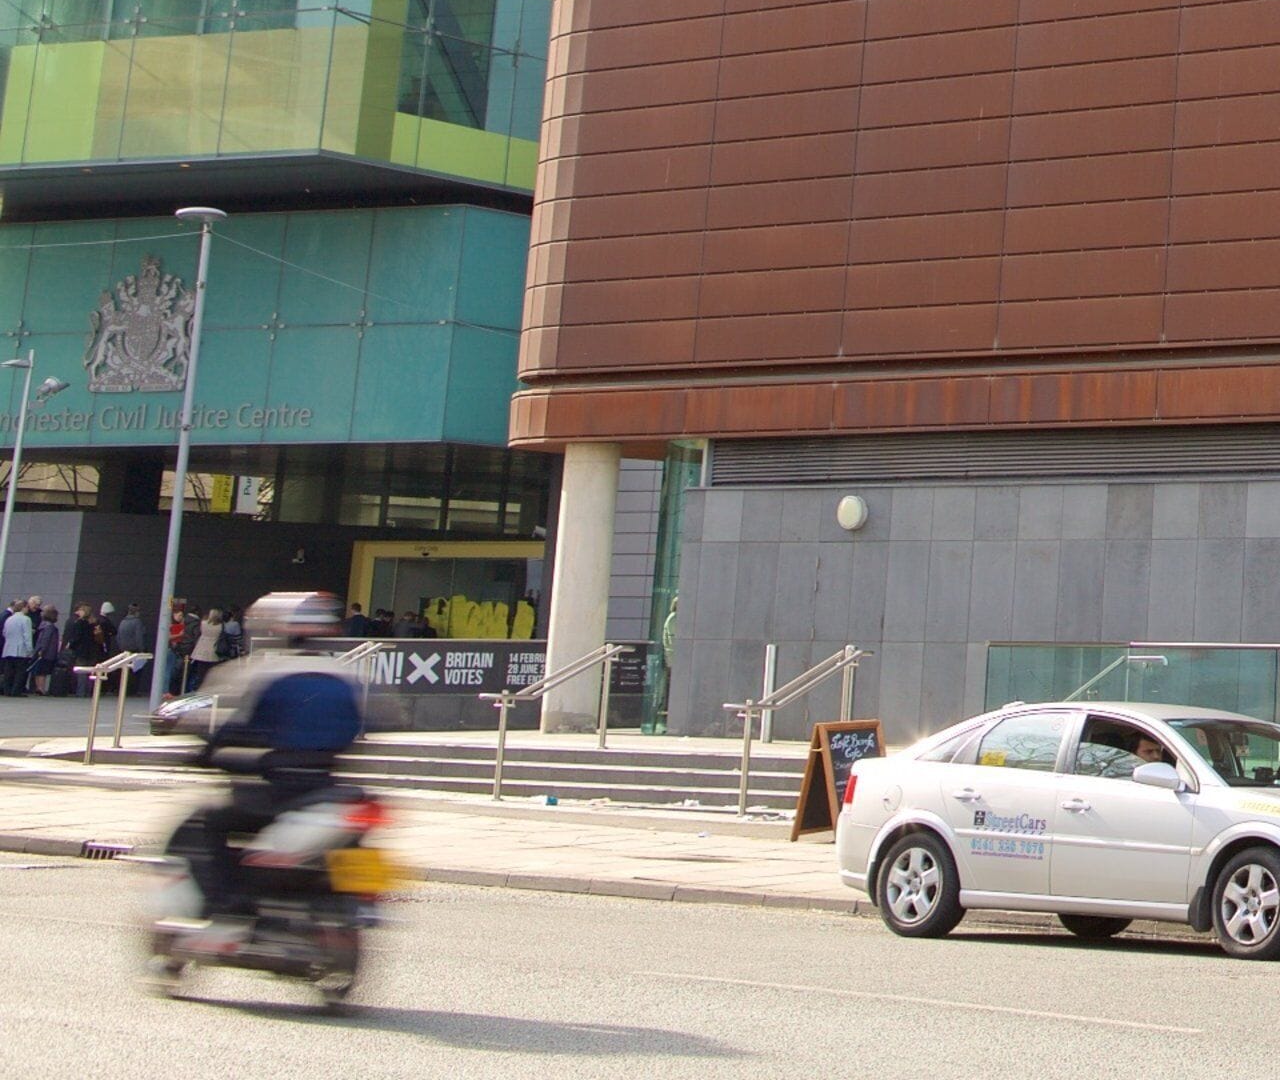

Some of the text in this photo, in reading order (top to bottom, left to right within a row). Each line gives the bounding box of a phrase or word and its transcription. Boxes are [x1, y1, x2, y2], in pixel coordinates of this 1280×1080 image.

[99, 403, 147, 429] Civil
[236, 403, 313, 428] Centre
[445, 652, 494, 669] BRITAIN
[509, 652, 519, 663] 14
[520, 663, 539, 674] JUNE
[444, 669, 484, 686] VOTES
[506, 674, 527, 686] FREE
